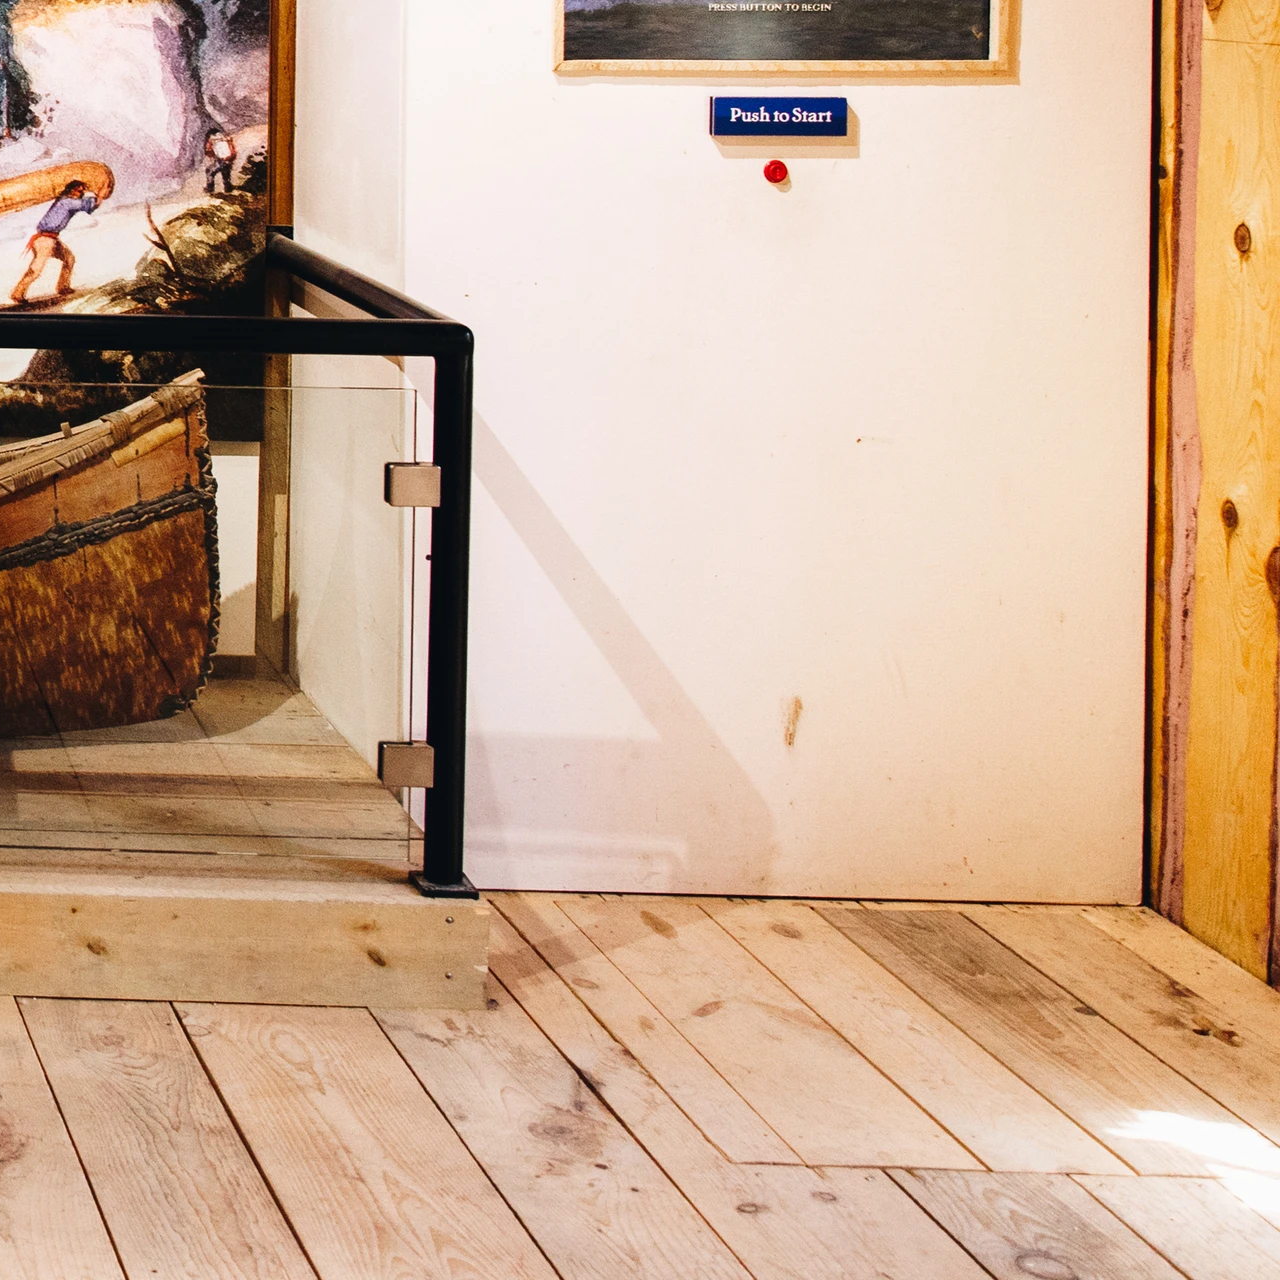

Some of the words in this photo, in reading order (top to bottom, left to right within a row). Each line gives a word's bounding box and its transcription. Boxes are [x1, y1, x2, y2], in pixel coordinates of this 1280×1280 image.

[708, 3, 738, 11] PRESS
[739, 3, 782, 11] BUTTON
[784, 3, 799, 11] TO
[801, 3, 831, 11] BEGIN
[730, 106, 771, 122] Push
[773, 110, 790, 122] to
[792, 107, 832, 122] Start
